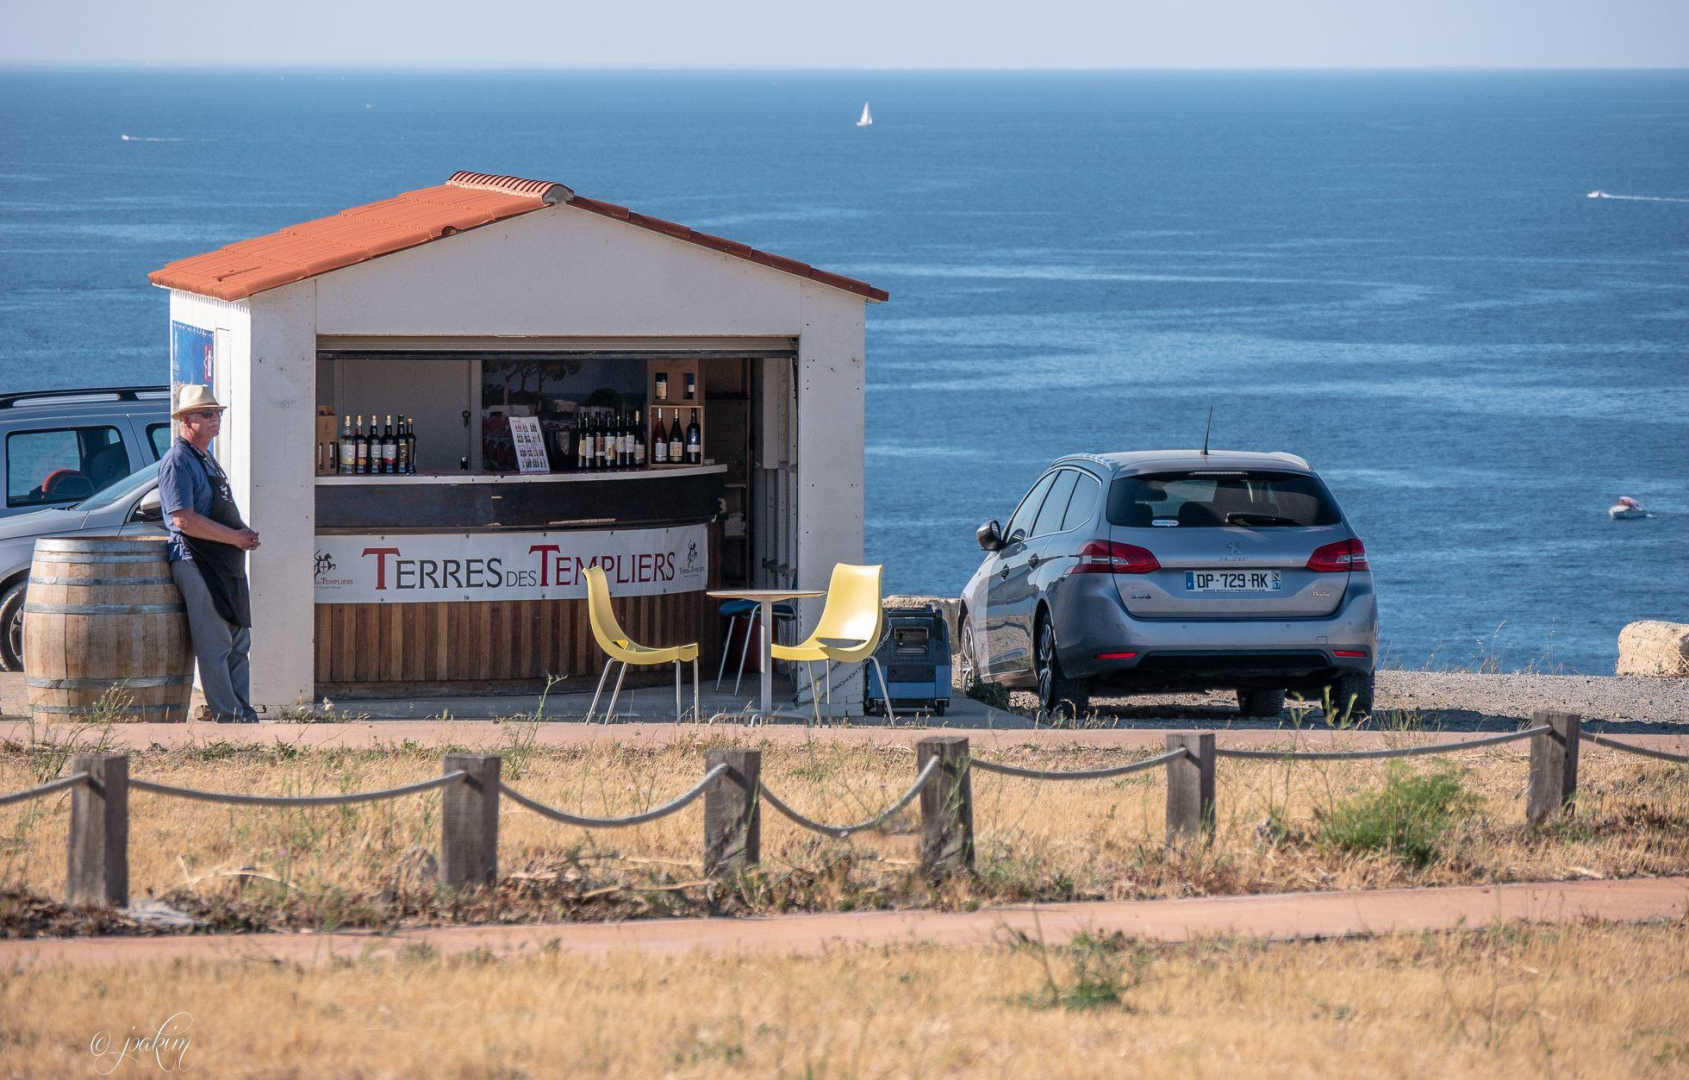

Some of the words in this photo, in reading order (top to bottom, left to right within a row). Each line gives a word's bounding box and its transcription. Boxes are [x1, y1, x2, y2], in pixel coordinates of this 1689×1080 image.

[361, 547, 503, 590] TERRES
[506, 570, 537, 587] DES
[1197, 573, 1269, 589] DP-729-RK
